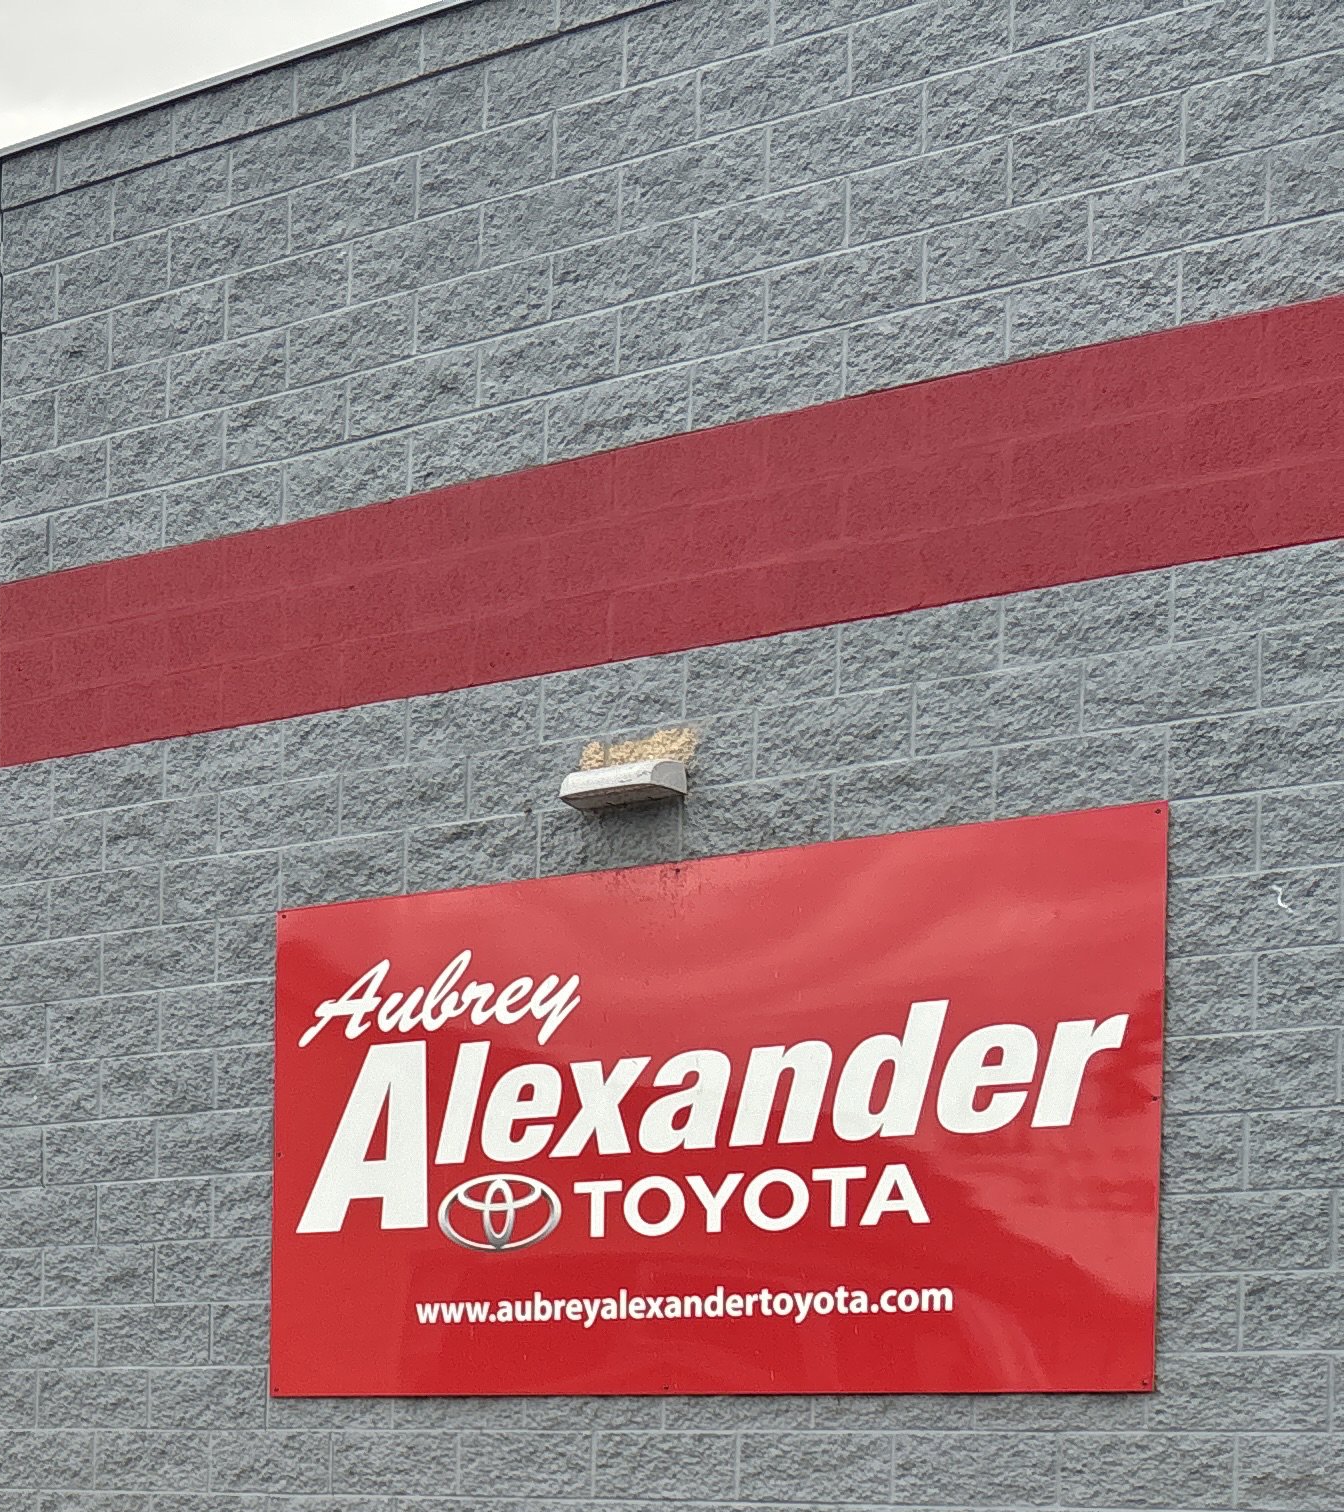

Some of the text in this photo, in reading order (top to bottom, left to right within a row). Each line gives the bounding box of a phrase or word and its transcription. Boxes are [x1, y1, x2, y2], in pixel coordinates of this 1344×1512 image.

[297, 948, 581, 1049] Aubrey
[295, 999, 1130, 1234] Alexander
[573, 1163, 931, 1238] TOYOTA
[415, 1285, 953, 1329] www.aubreyalexandertoyota.com
